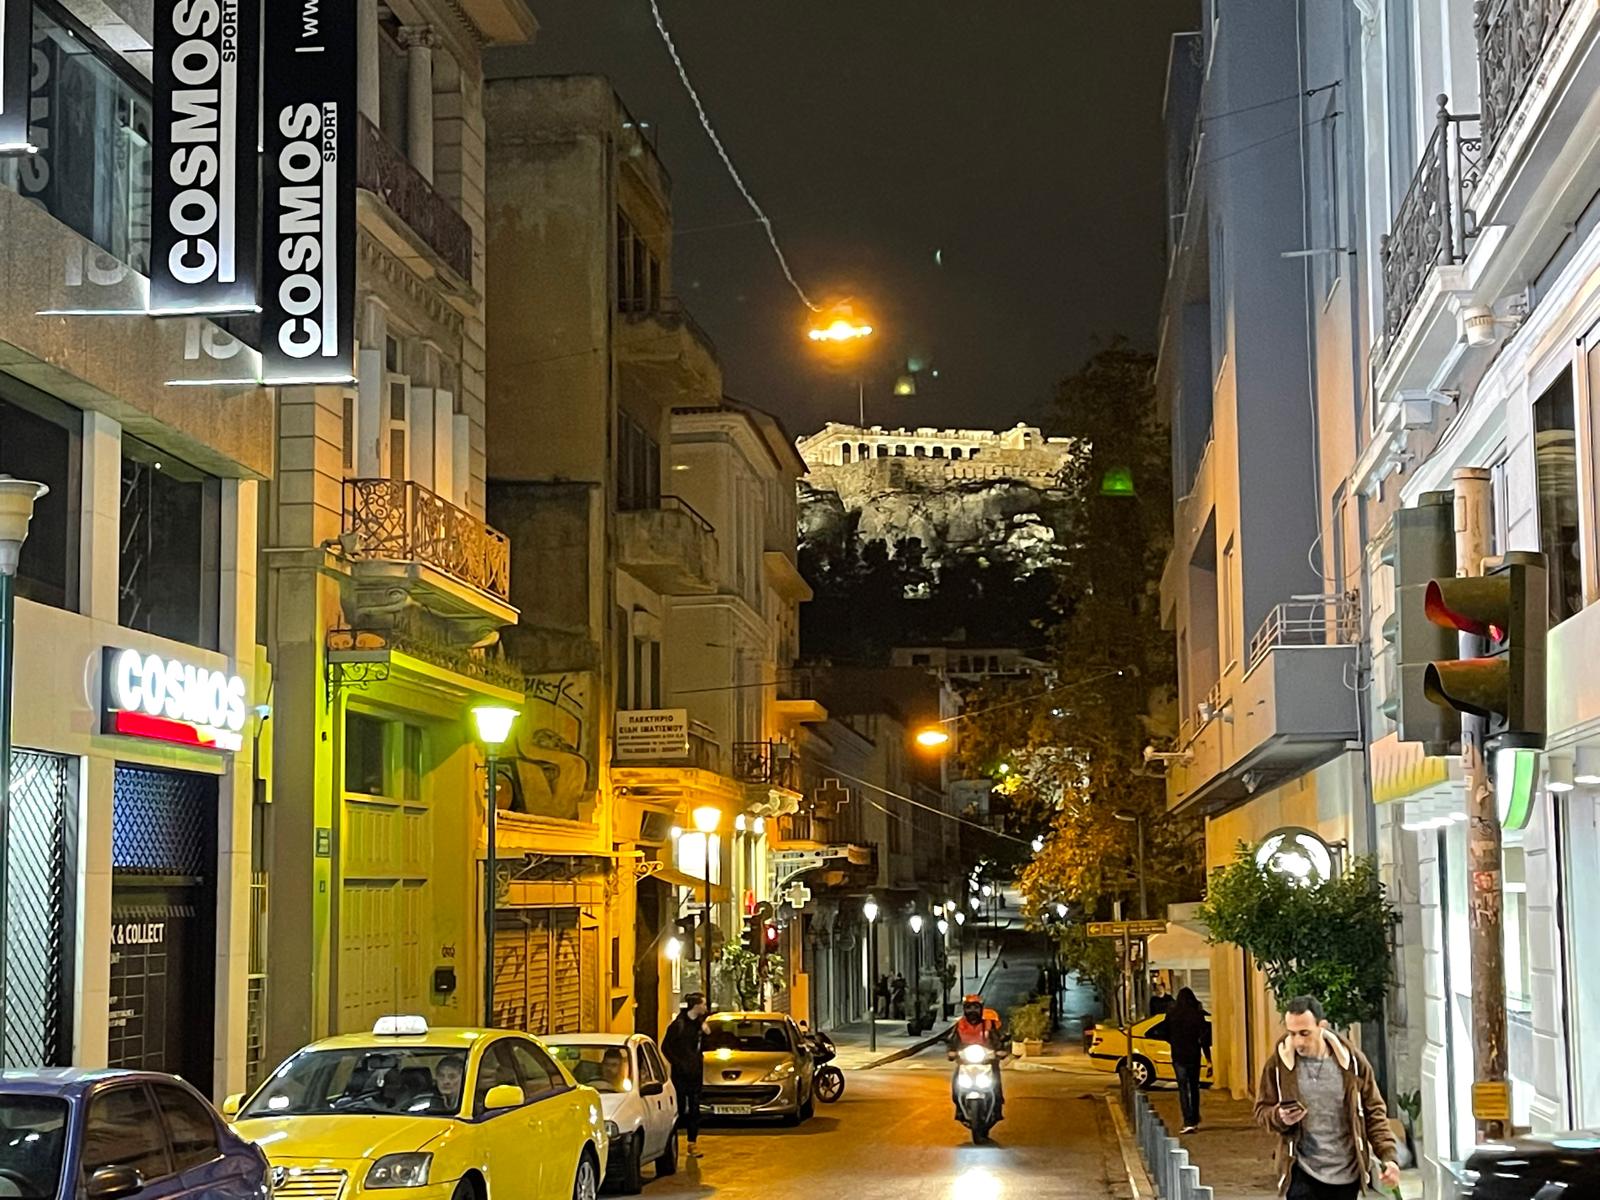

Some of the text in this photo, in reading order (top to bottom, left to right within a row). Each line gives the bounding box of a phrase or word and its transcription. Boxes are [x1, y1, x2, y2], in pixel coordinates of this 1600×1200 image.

[222, 0, 237, 62] SPORT
[168, 0, 219, 284] COSMOS
[323, 105, 337, 162] SPORT
[278, 103, 321, 358] COSMOS
[117, 648, 245, 731] COSMOS
[117, 924, 124, 944] &
[125, 923, 165, 944] COLLECT
